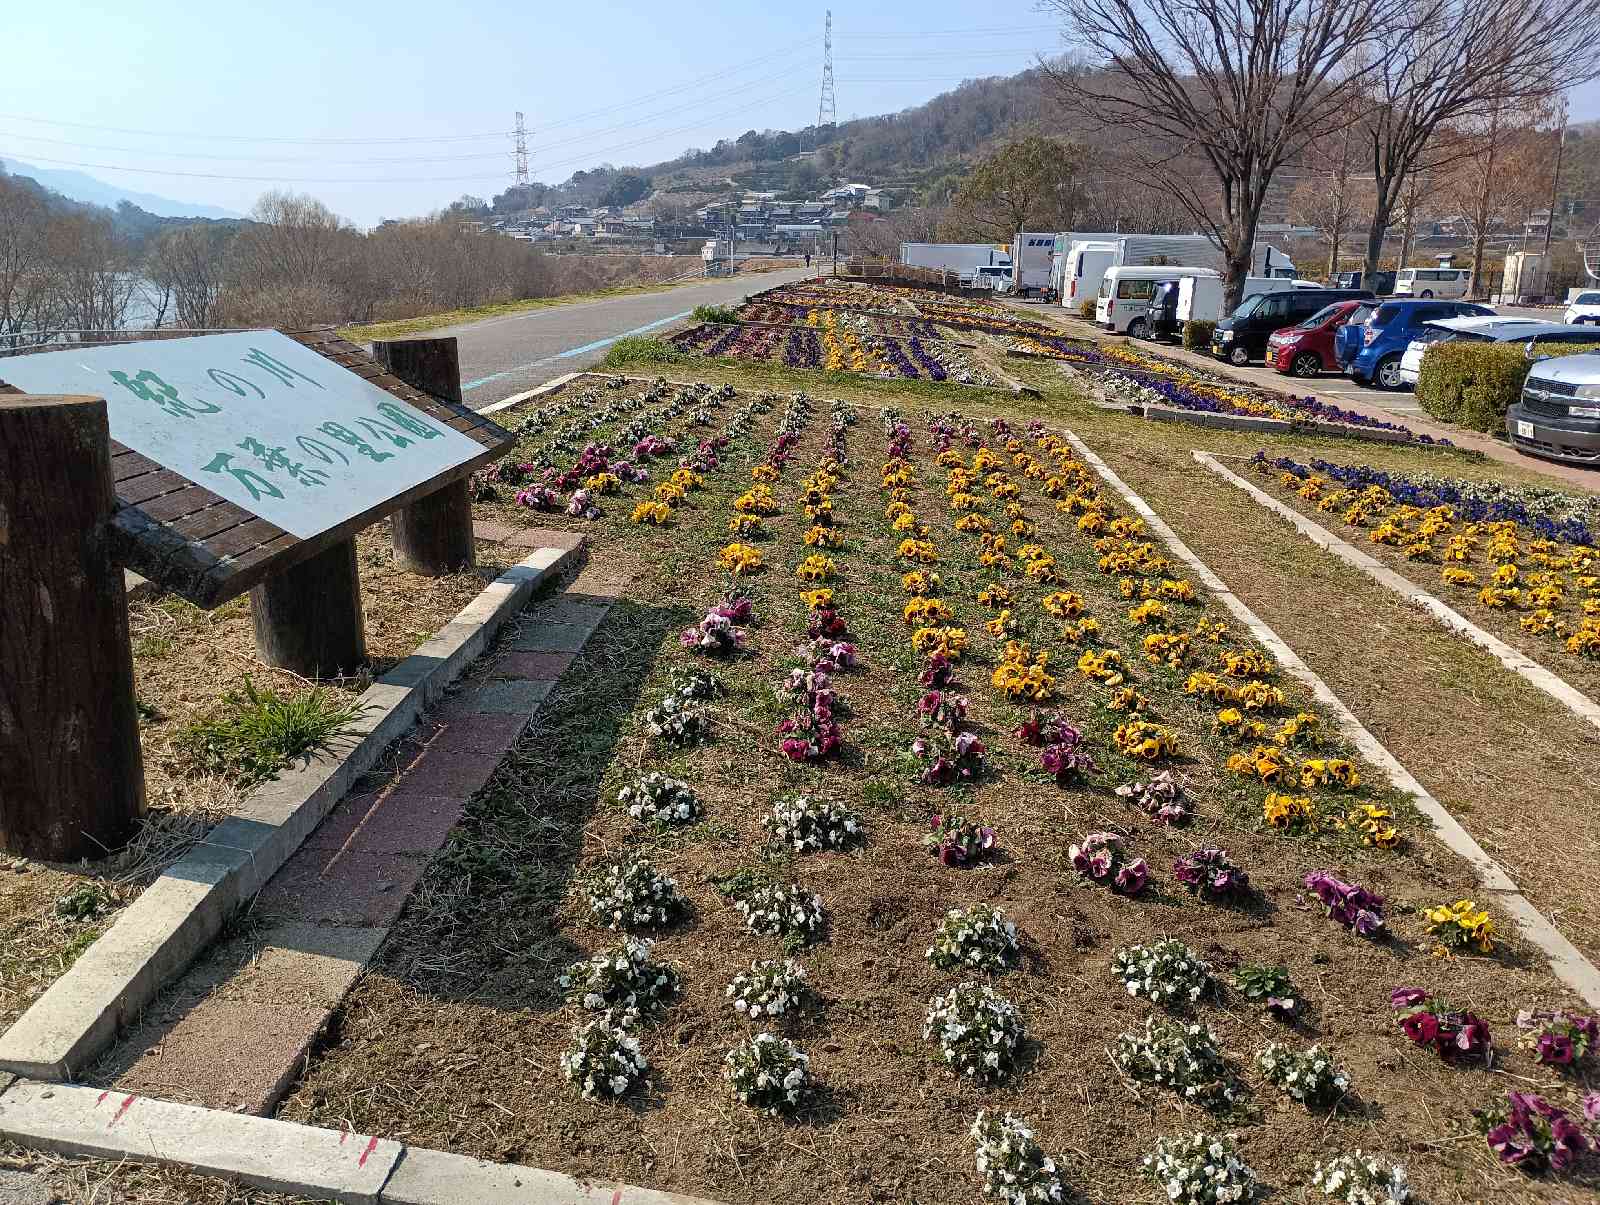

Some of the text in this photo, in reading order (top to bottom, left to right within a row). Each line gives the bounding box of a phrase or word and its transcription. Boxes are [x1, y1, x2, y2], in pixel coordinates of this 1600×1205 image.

[108, 347, 327, 419] 紀の川
[200, 401, 446, 501] 万葉の里公園
